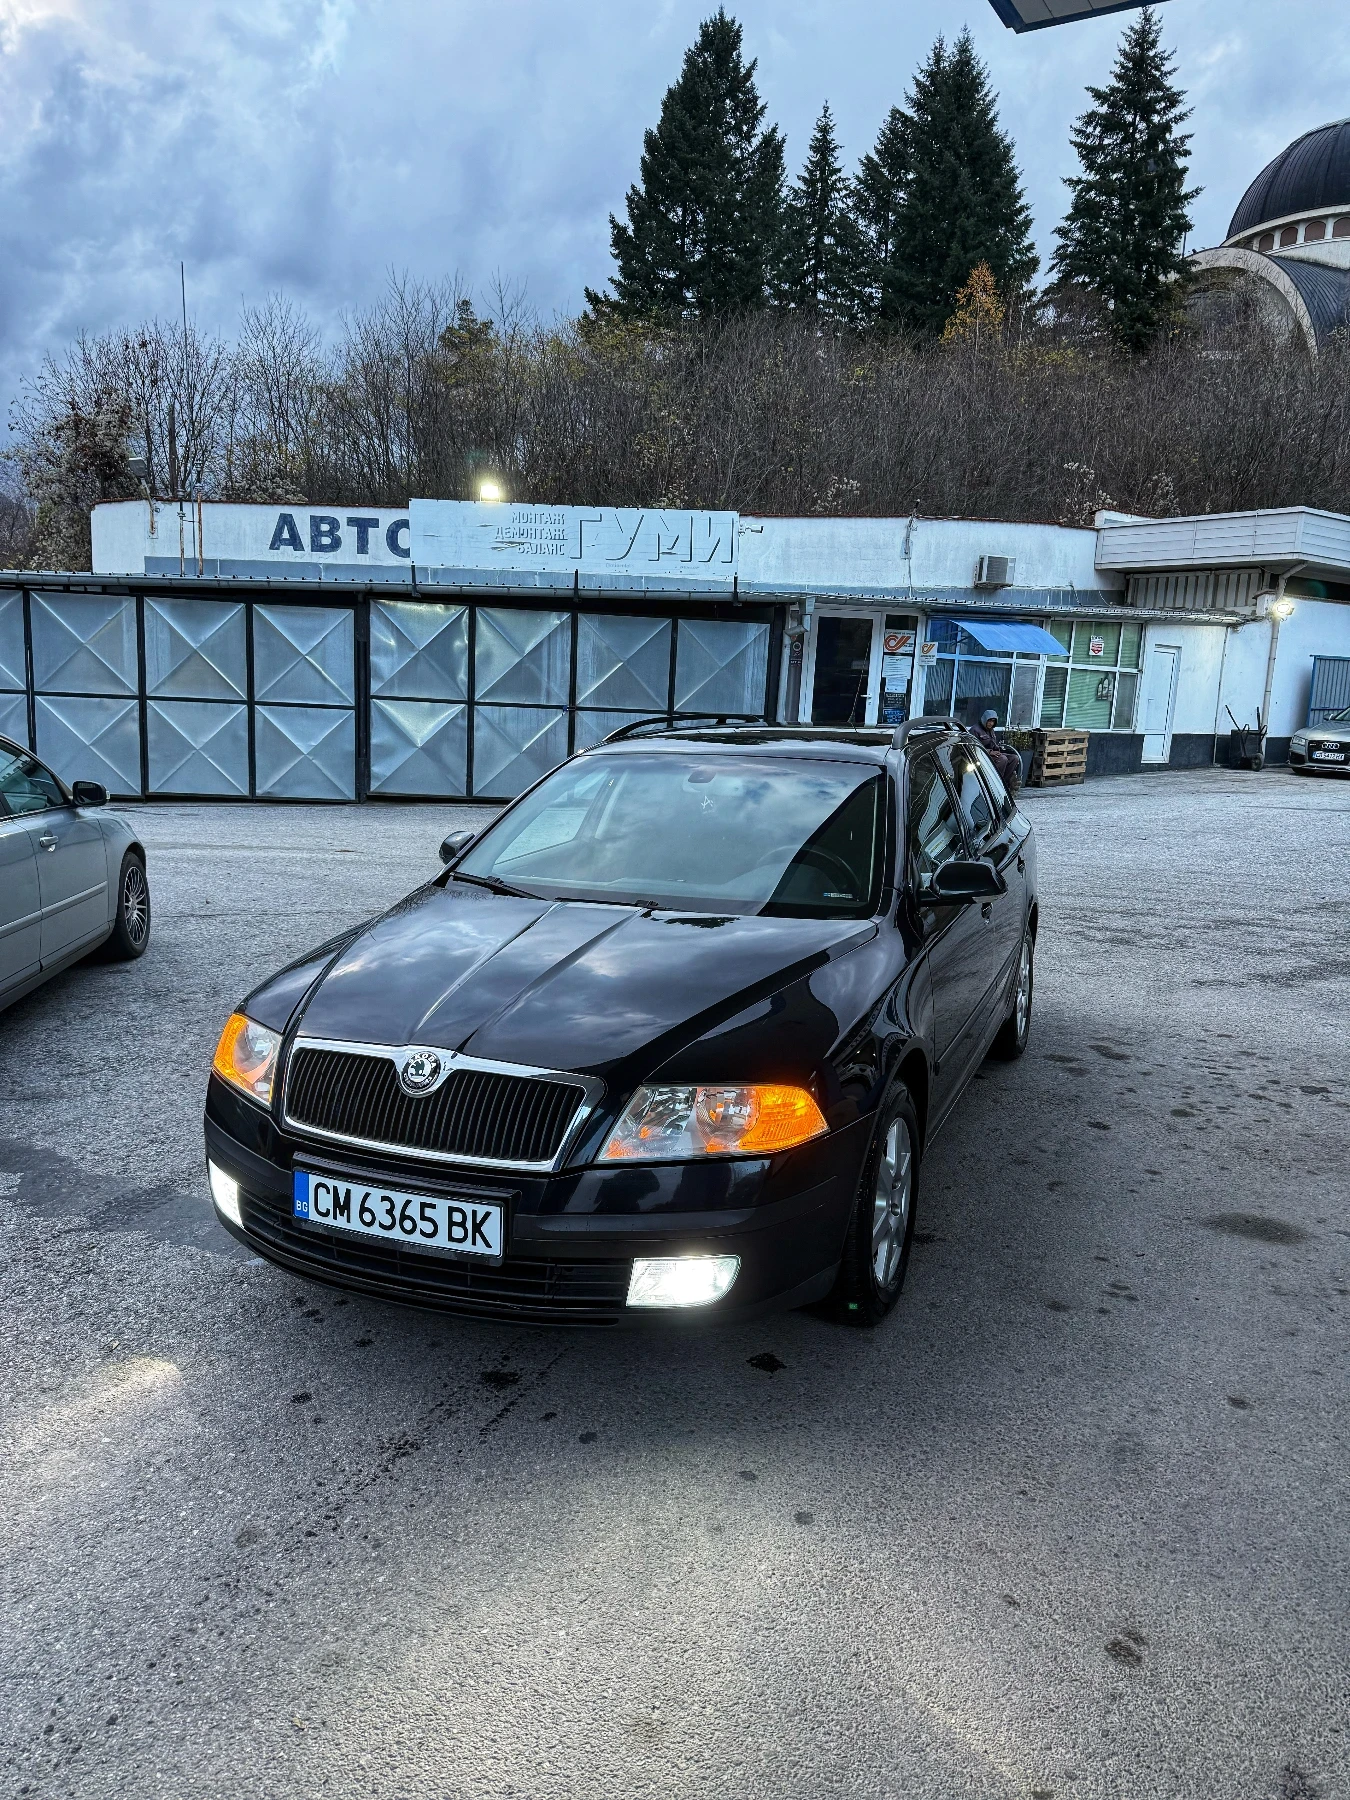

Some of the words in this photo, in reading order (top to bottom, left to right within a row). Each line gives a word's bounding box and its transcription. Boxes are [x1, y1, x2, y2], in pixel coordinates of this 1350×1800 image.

[510, 511, 565, 525] МОНТАЖ
[494, 526, 566, 540] ДЕМОНТАЖ
[569, 512, 734, 564] ГУМИ
[296, 1200, 308, 1213] BG
[313, 1181, 352, 1224] CM
[358, 1191, 439, 1239] 6365
[447, 1205, 493, 1249] BK
